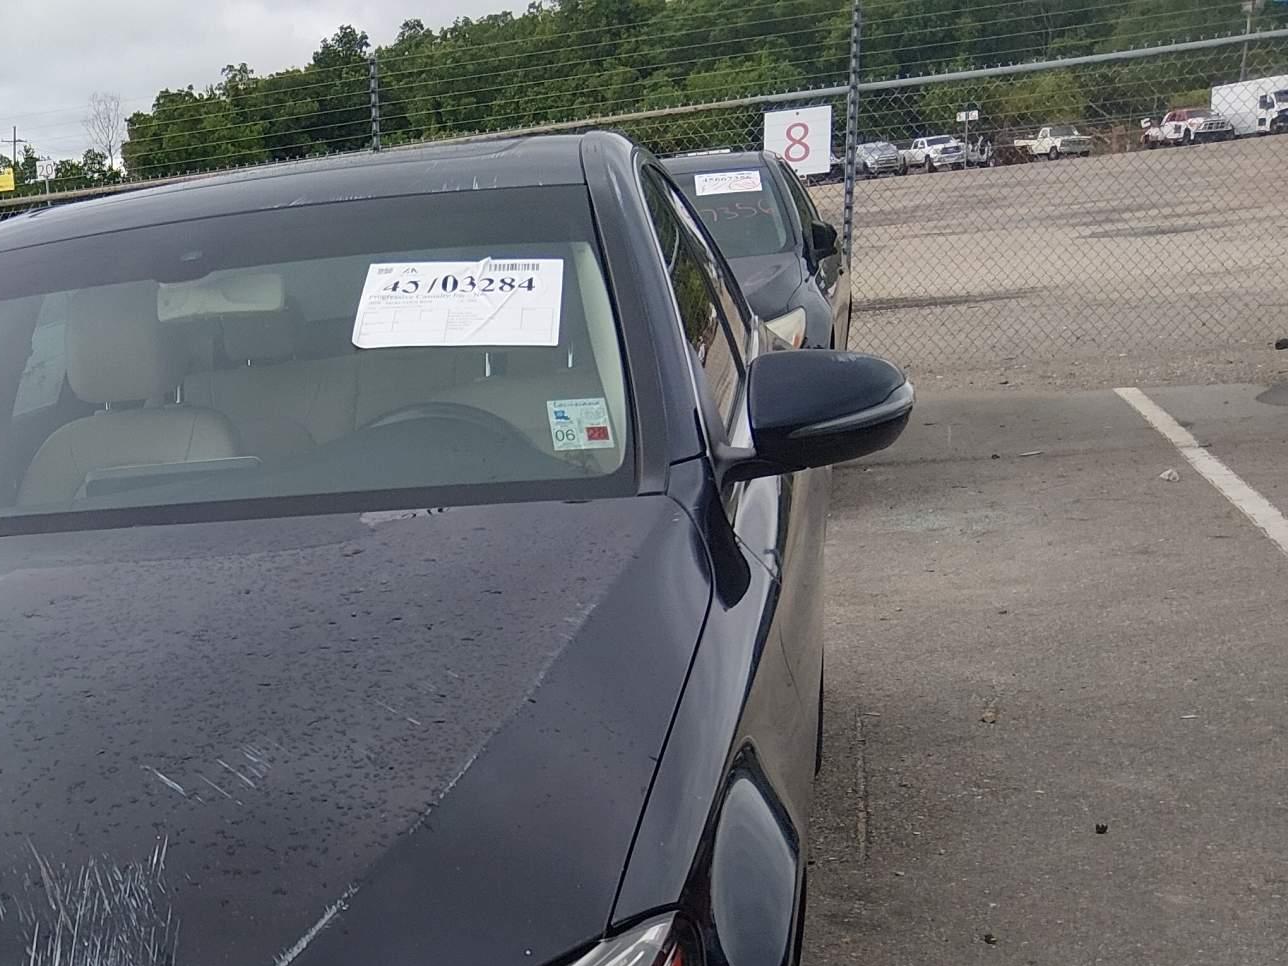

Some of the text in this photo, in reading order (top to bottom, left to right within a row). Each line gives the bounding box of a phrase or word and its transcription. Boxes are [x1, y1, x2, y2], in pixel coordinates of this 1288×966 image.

[784, 122, 810, 162] 8
[37, 164, 54, 176] 20
[555, 429, 576, 442] 06
